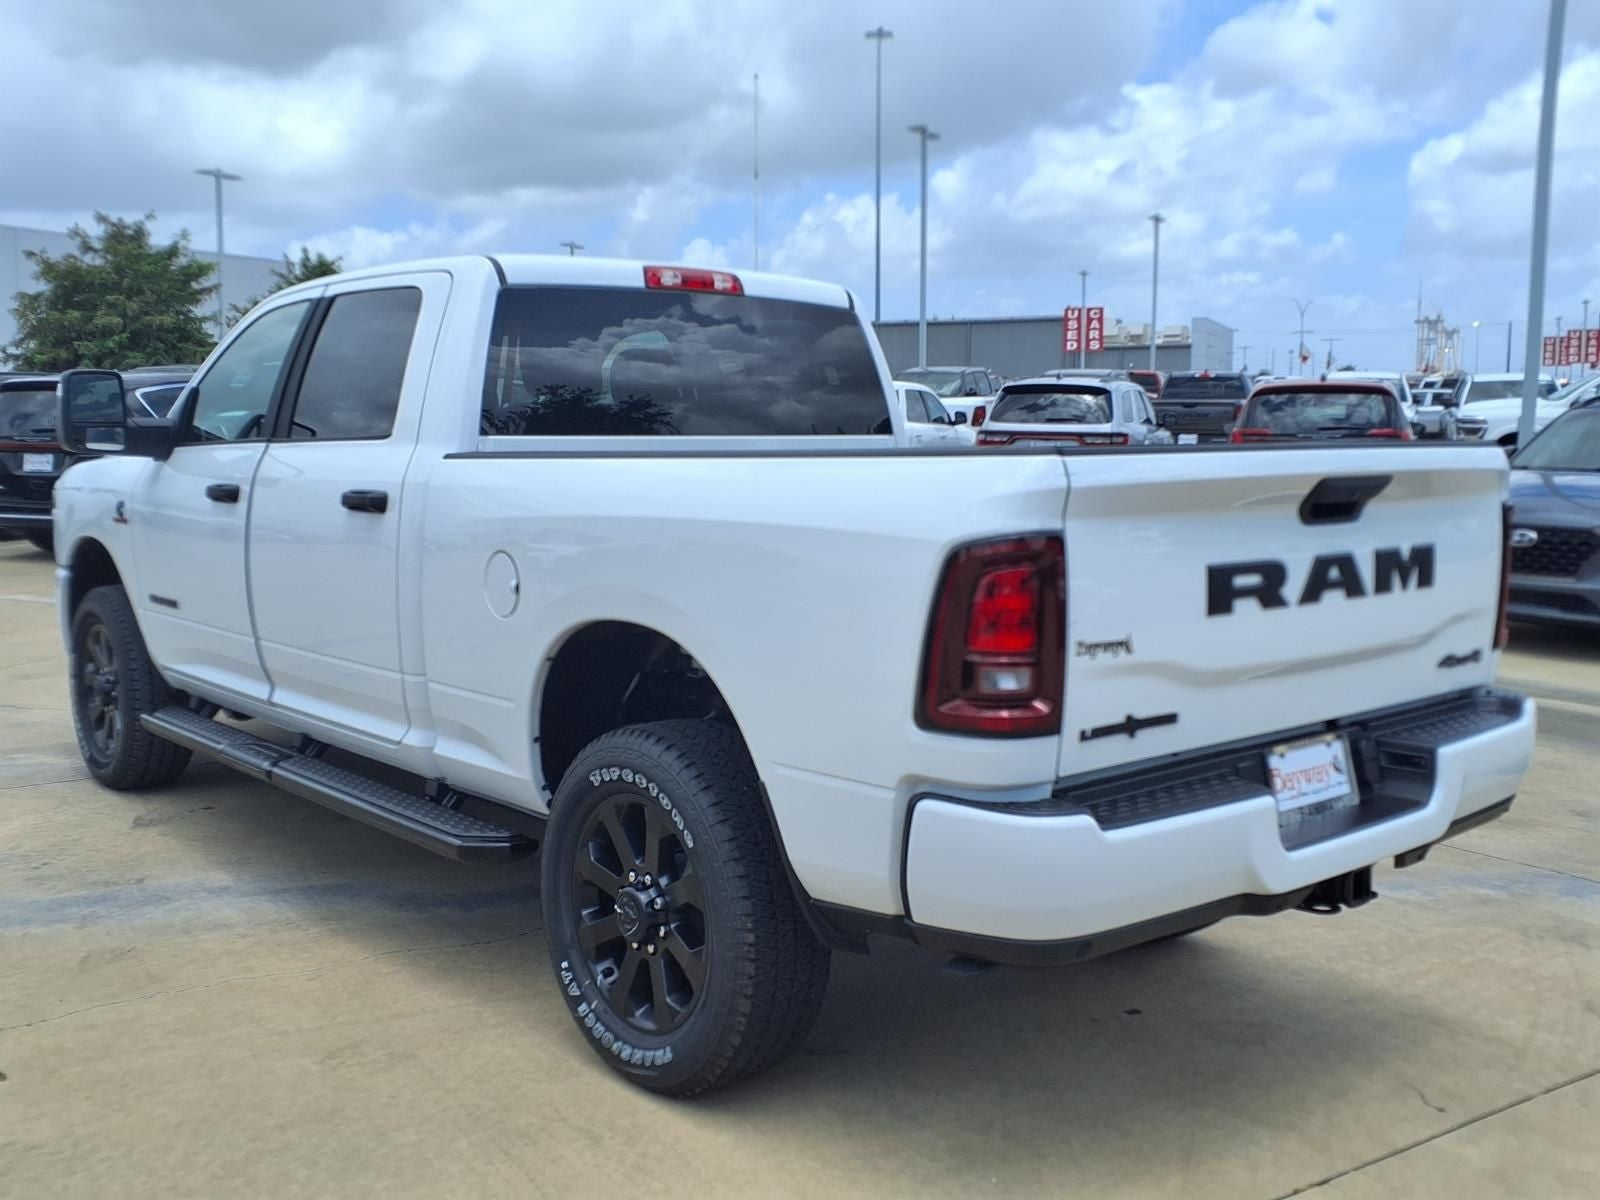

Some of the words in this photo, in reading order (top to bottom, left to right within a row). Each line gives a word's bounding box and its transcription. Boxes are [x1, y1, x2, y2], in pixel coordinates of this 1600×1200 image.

[1066, 309, 1079, 351] USED
[1089, 309, 1101, 351] CARS
[1206, 543, 1436, 618] RAM
[1267, 764, 1332, 801] Bayway
